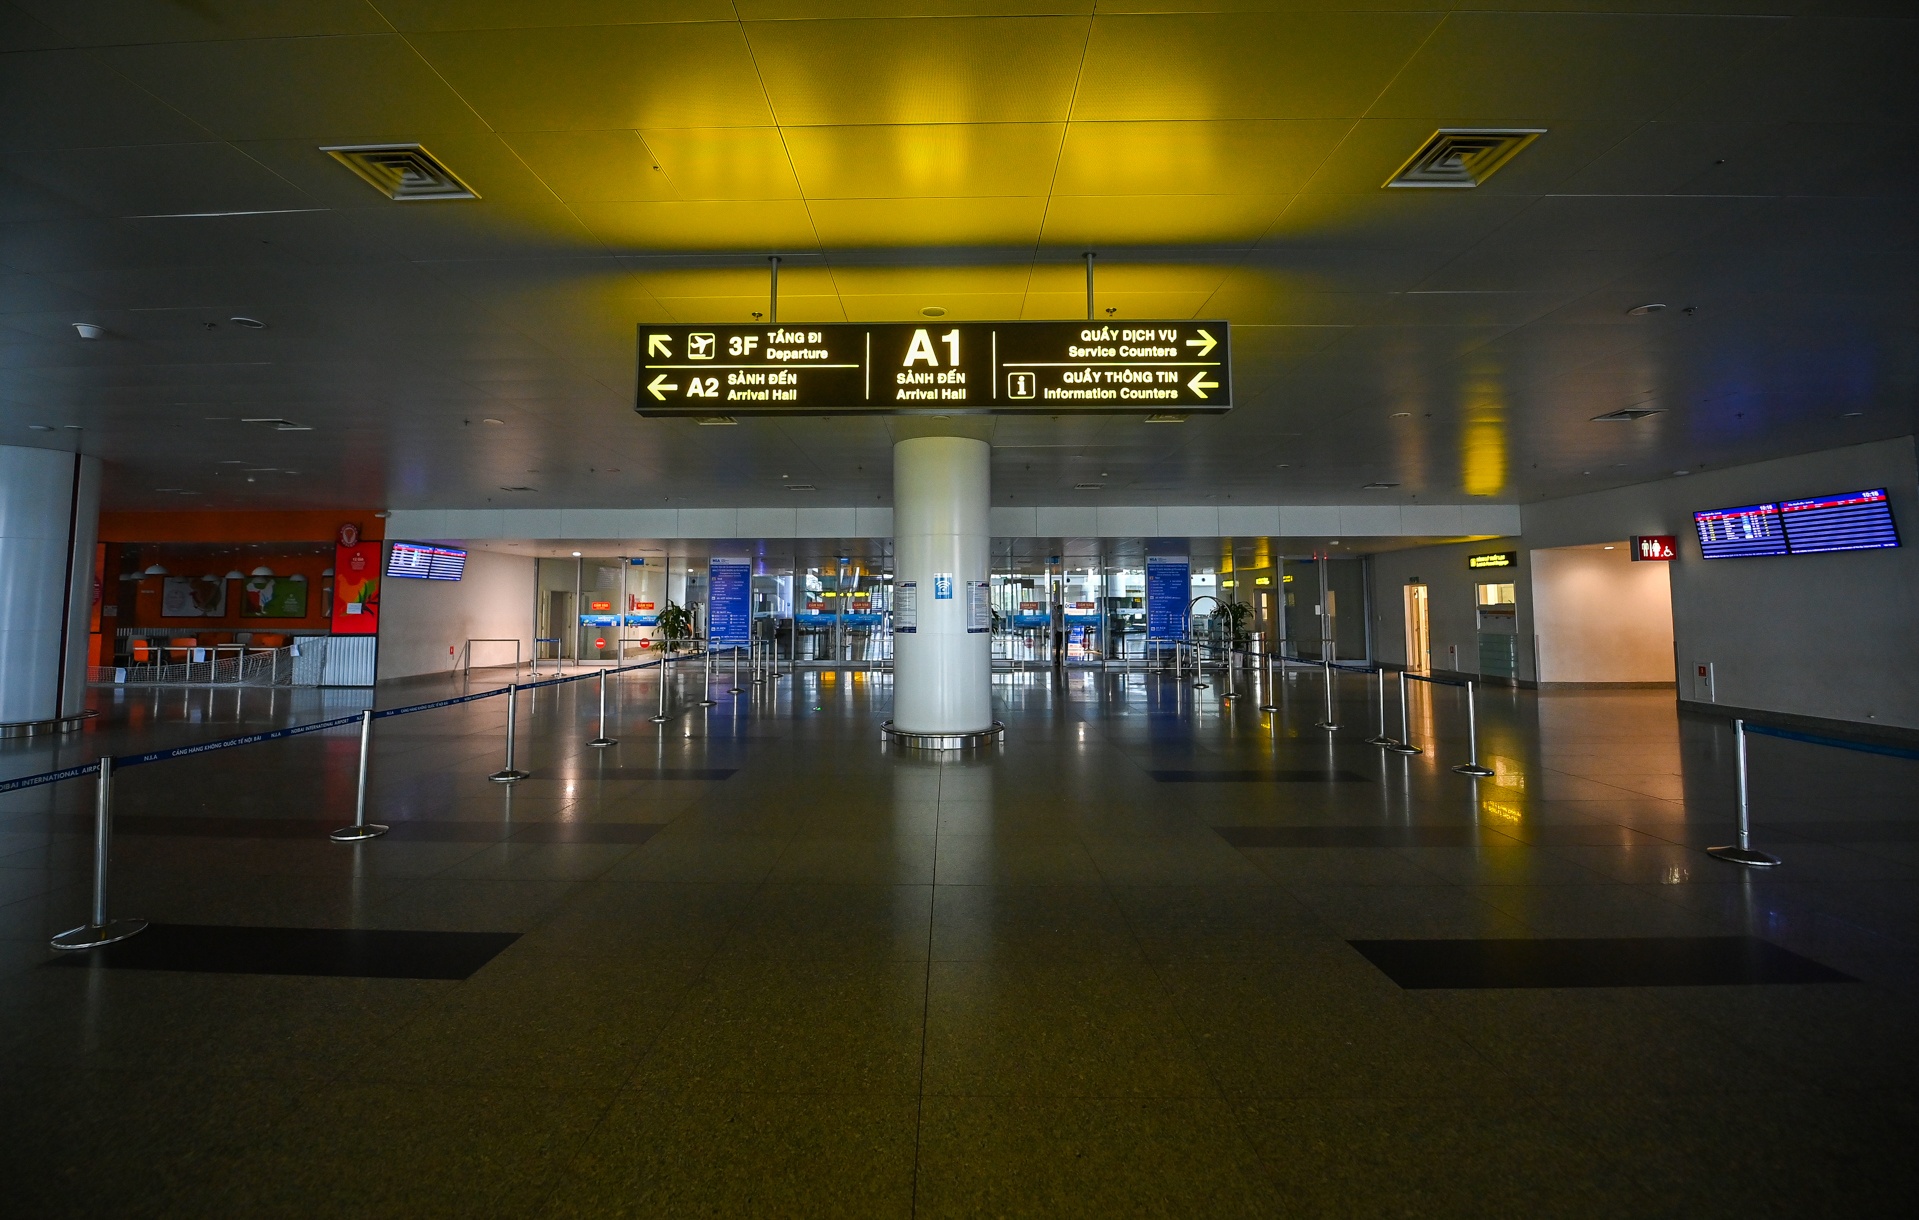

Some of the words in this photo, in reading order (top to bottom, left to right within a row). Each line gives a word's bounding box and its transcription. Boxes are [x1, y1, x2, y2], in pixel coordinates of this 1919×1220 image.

[1122, 329, 1155, 343] DỊCH
[1158, 329, 1177, 343] VỤ
[728, 335, 759, 356] 3F
[808, 332, 822, 344] ĐI
[902, 328, 960, 367] A1
[766, 348, 829, 361] Departure
[1068, 346, 1116, 358] Service
[1119, 346, 1177, 357] Counters
[727, 370, 765, 385] SẢNH
[768, 369, 797, 385] ĐẾN
[896, 369, 934, 384] SẢNH
[937, 368, 966, 384] ĐẾN
[1104, 369, 1153, 383] THÔNG
[1155, 371, 1178, 383] TIN
[686, 377, 720, 398] A2
[896, 388, 938, 400] Arrival
[941, 388, 966, 400] Hall
[1044, 387, 1117, 400] Information
[1120, 387, 1178, 400] Counters
[727, 389, 769, 401] Arrival
[772, 389, 797, 401] Hall
[21, 769, 80, 787] INTERNATIONAL
